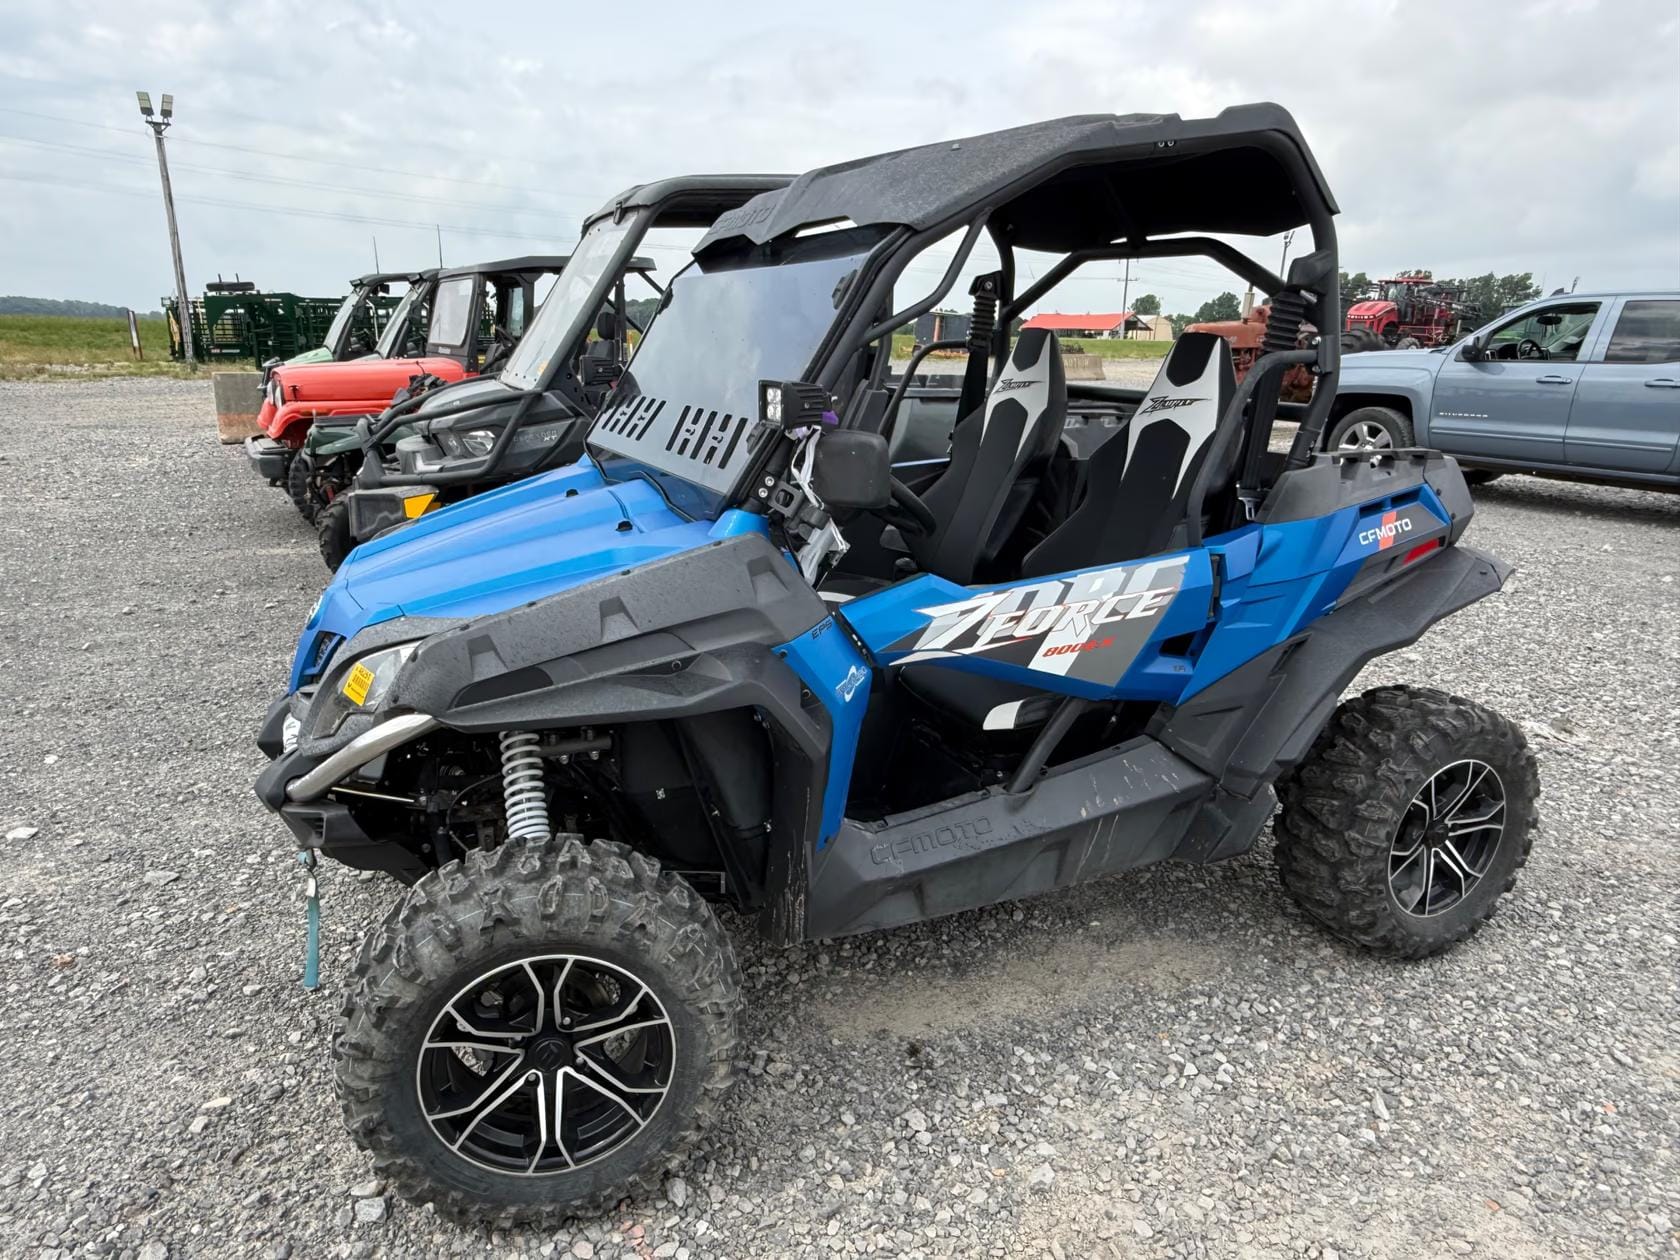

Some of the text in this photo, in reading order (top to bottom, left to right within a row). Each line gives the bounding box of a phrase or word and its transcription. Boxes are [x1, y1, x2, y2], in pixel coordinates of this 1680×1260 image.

[1358, 518, 1412, 545] CFMOTO
[811, 618, 833, 640] EPS
[870, 816, 993, 866] CFMOTO
